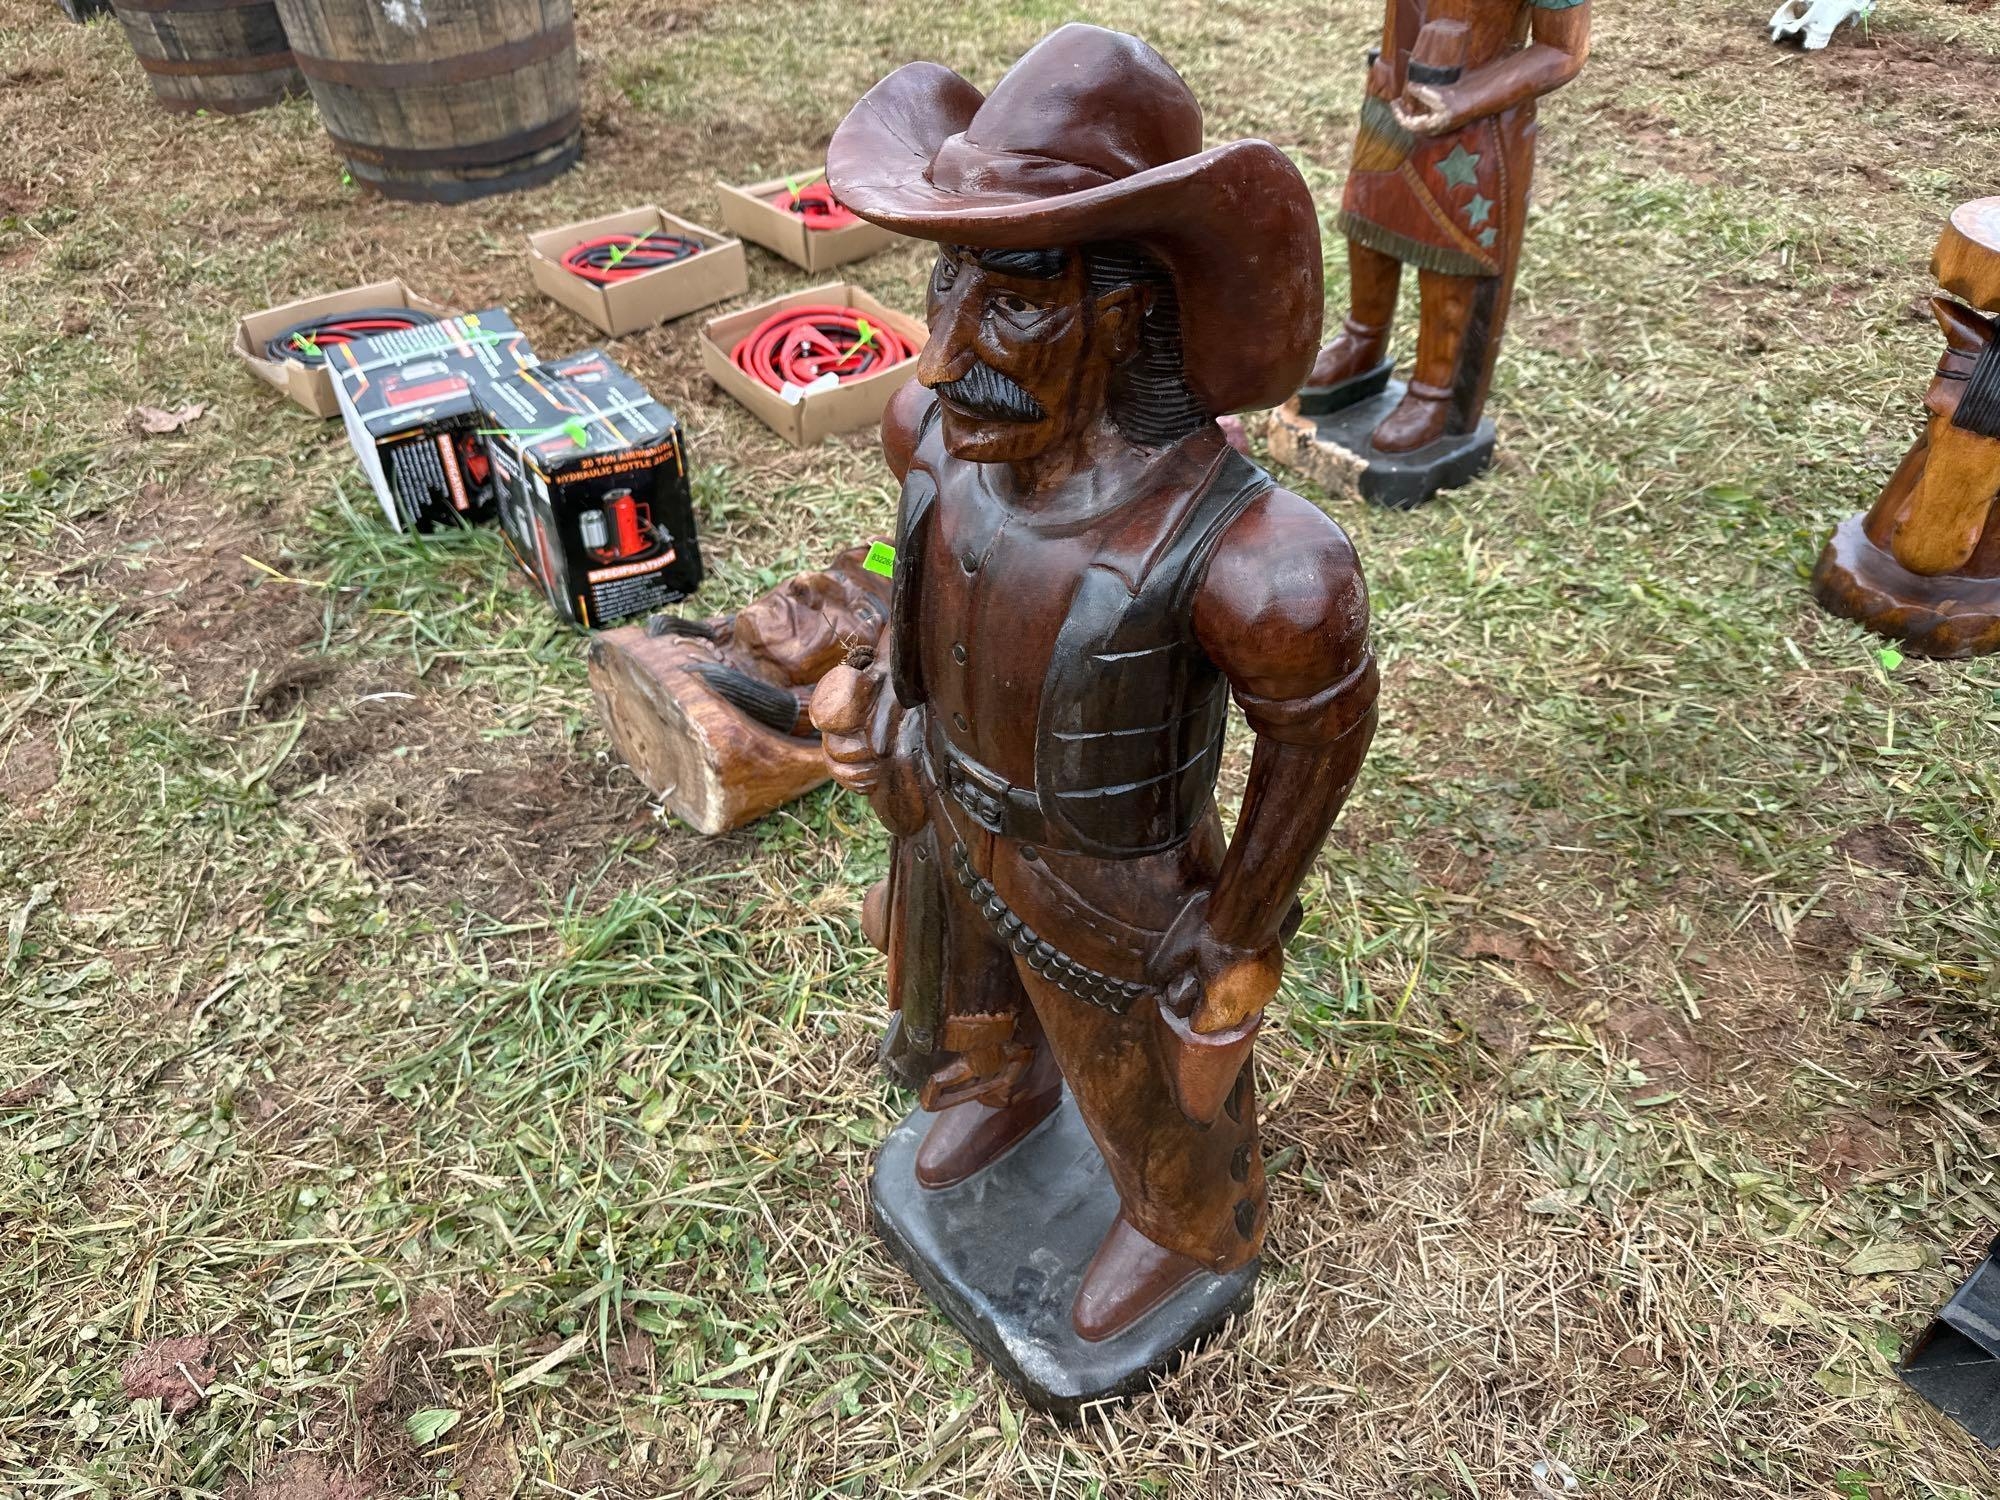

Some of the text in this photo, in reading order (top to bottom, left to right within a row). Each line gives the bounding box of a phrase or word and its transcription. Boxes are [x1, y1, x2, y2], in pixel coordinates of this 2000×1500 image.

[555, 450, 674, 484] HYDRAULIC BOTTLE JACK
[581, 458, 594, 470] 20
[595, 455, 617, 466] TON
[589, 550, 676, 583] SPECIFICATIONS
